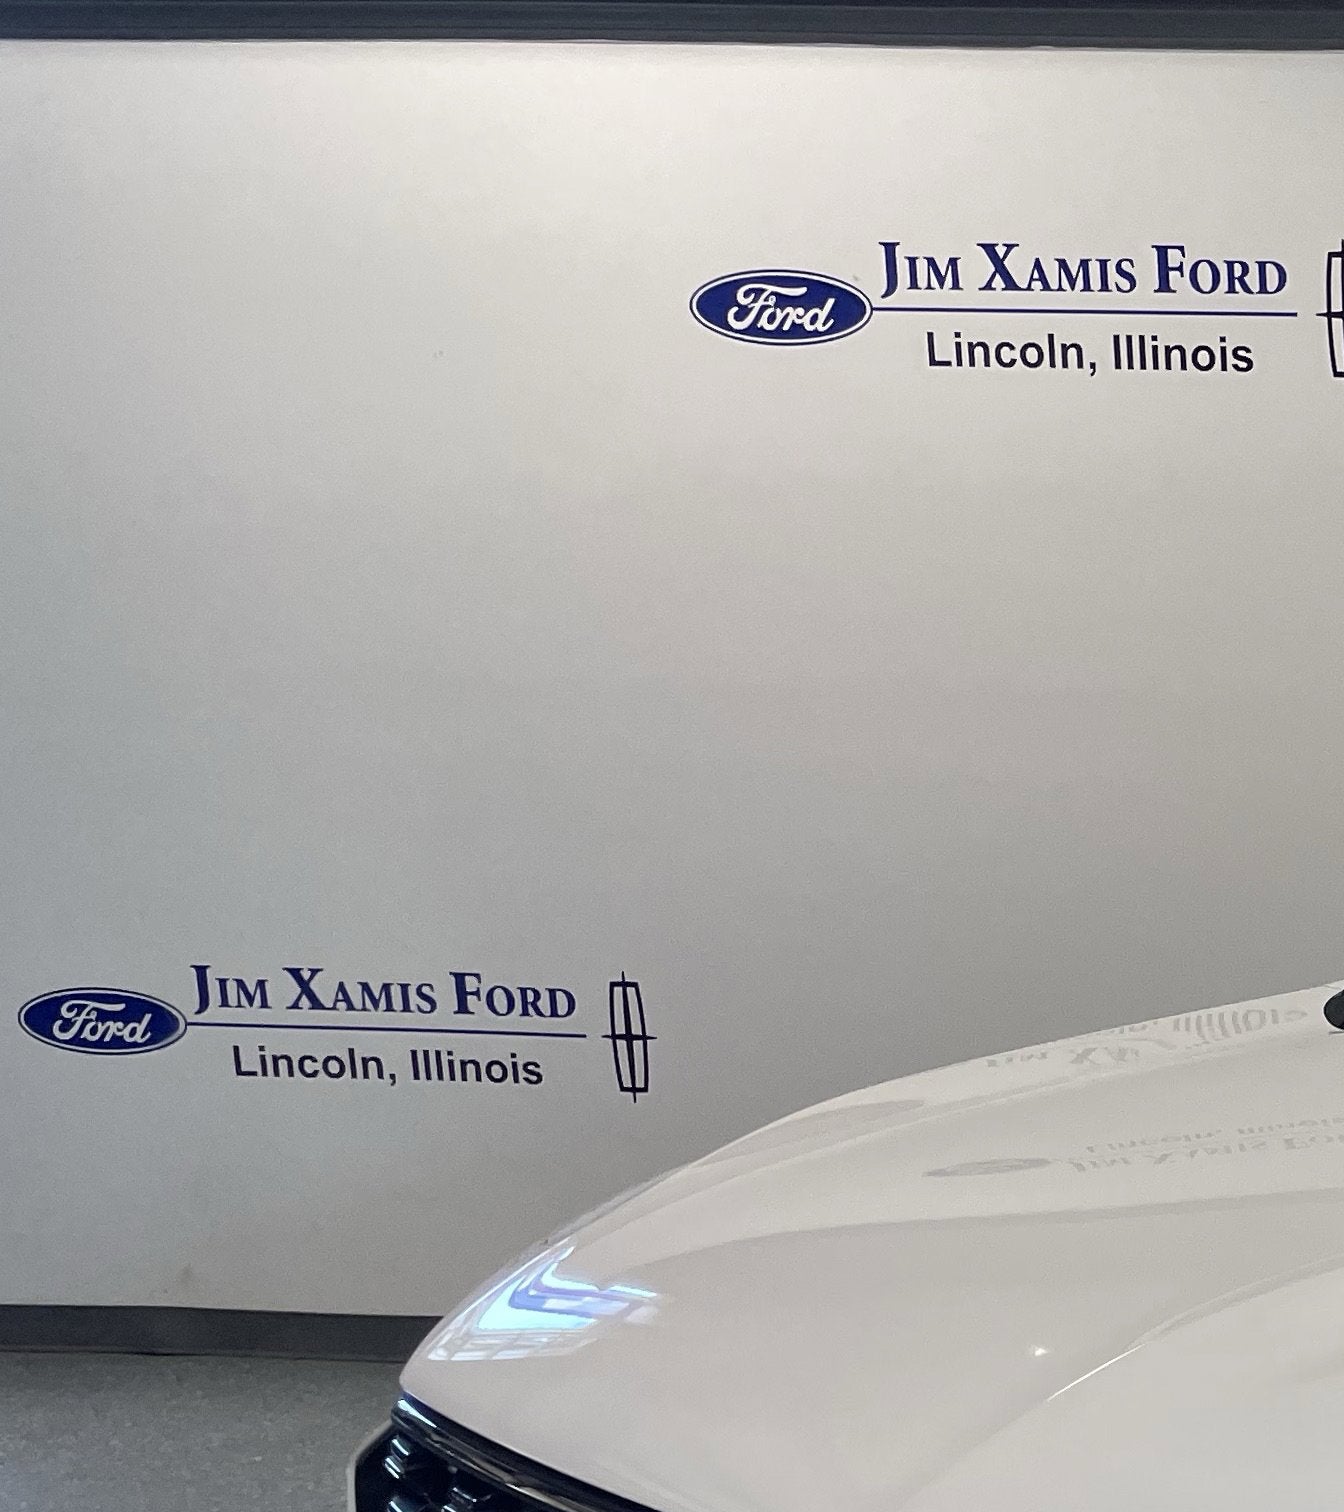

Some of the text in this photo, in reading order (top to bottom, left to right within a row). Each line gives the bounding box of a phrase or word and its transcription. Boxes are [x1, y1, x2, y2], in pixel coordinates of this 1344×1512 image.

[878, 241, 1287, 299] JIM XAMIS FORD
[726, 283, 836, 333] Ford
[926, 331, 1255, 377] Lincoln, Illinois
[189, 964, 577, 1019] JIM XAMIS FORD
[52, 999, 153, 1044] Ford
[232, 1045, 543, 1087] Lincoln, Illinois
